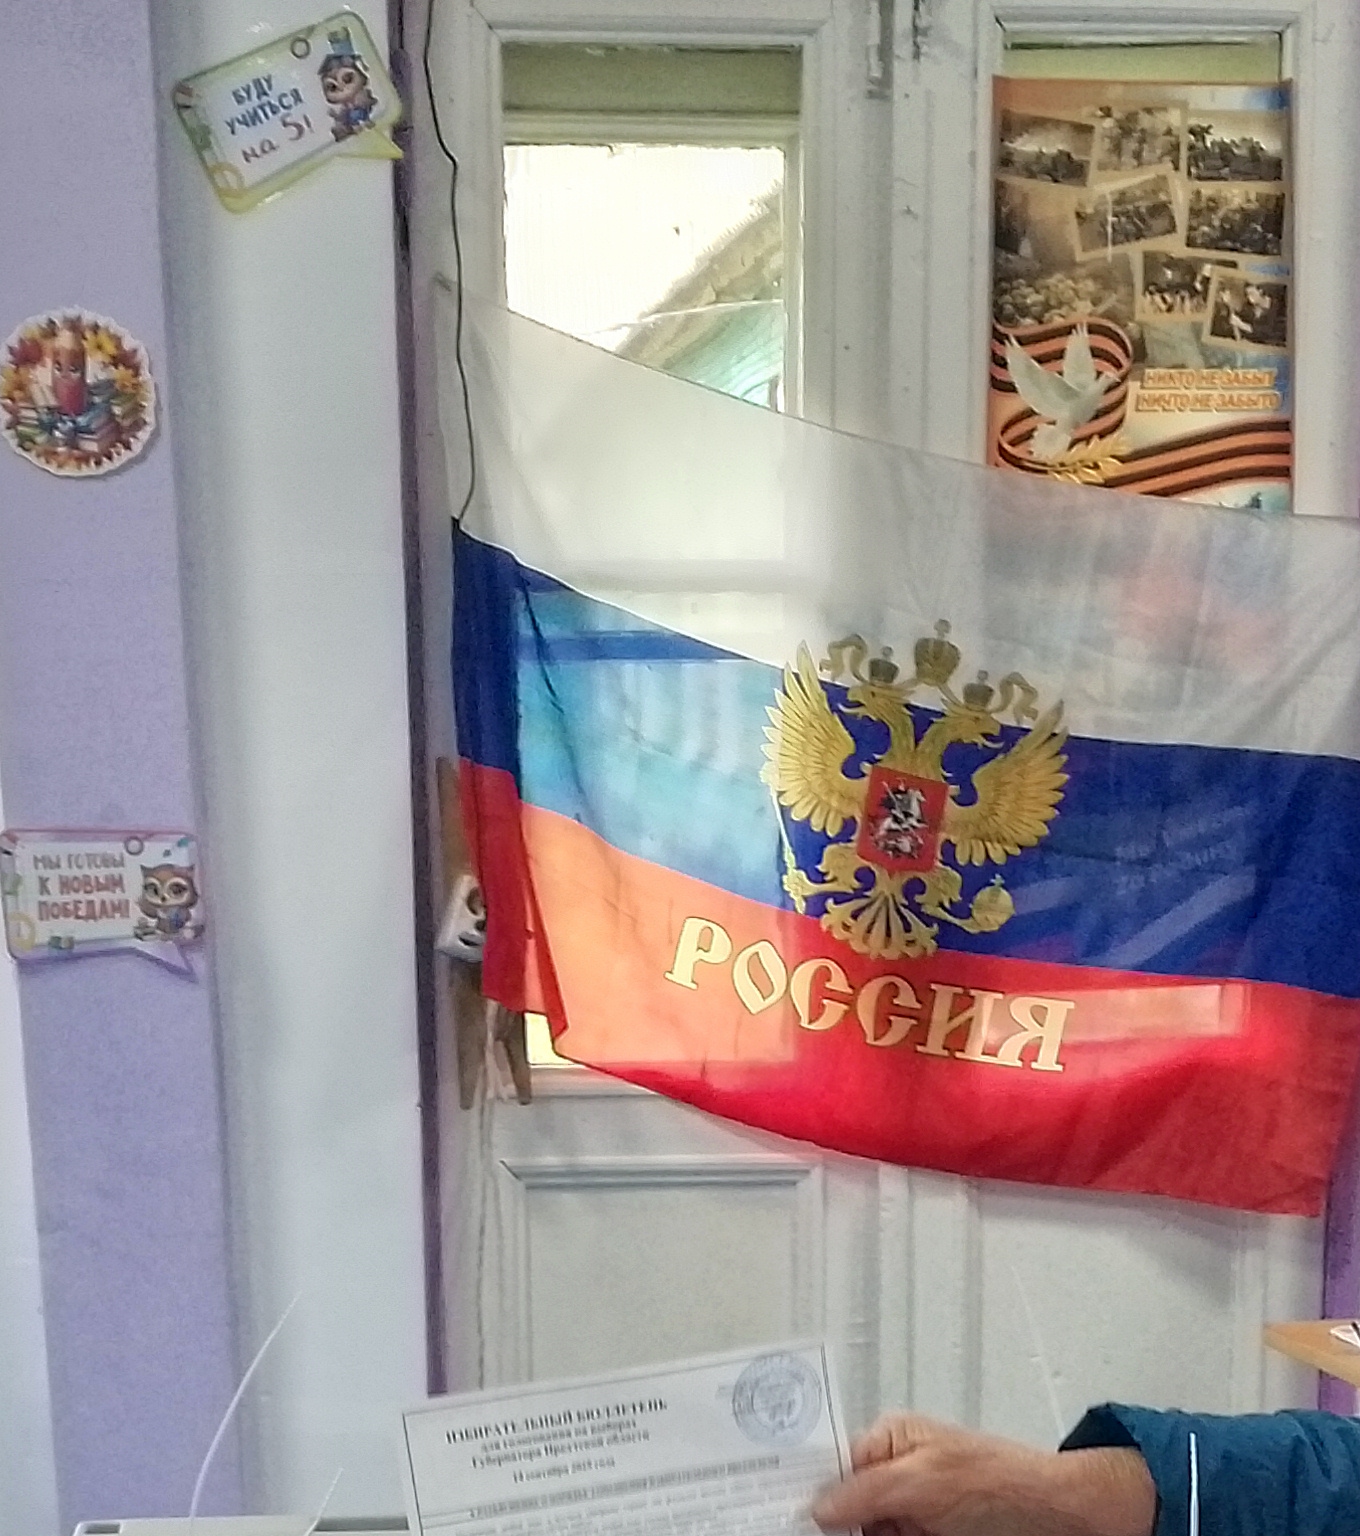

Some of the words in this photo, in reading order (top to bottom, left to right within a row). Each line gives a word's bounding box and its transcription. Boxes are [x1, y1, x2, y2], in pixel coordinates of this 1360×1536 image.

[232, 74, 273, 105] БУДУ
[225, 88, 304, 135] УЧИТЬСЯ
[33, 854, 61, 870] МЫ
[38, 875, 51, 896] К
[59, 873, 126, 895] НОВЫМ
[663, 916, 1076, 1072] РОССИЯ
